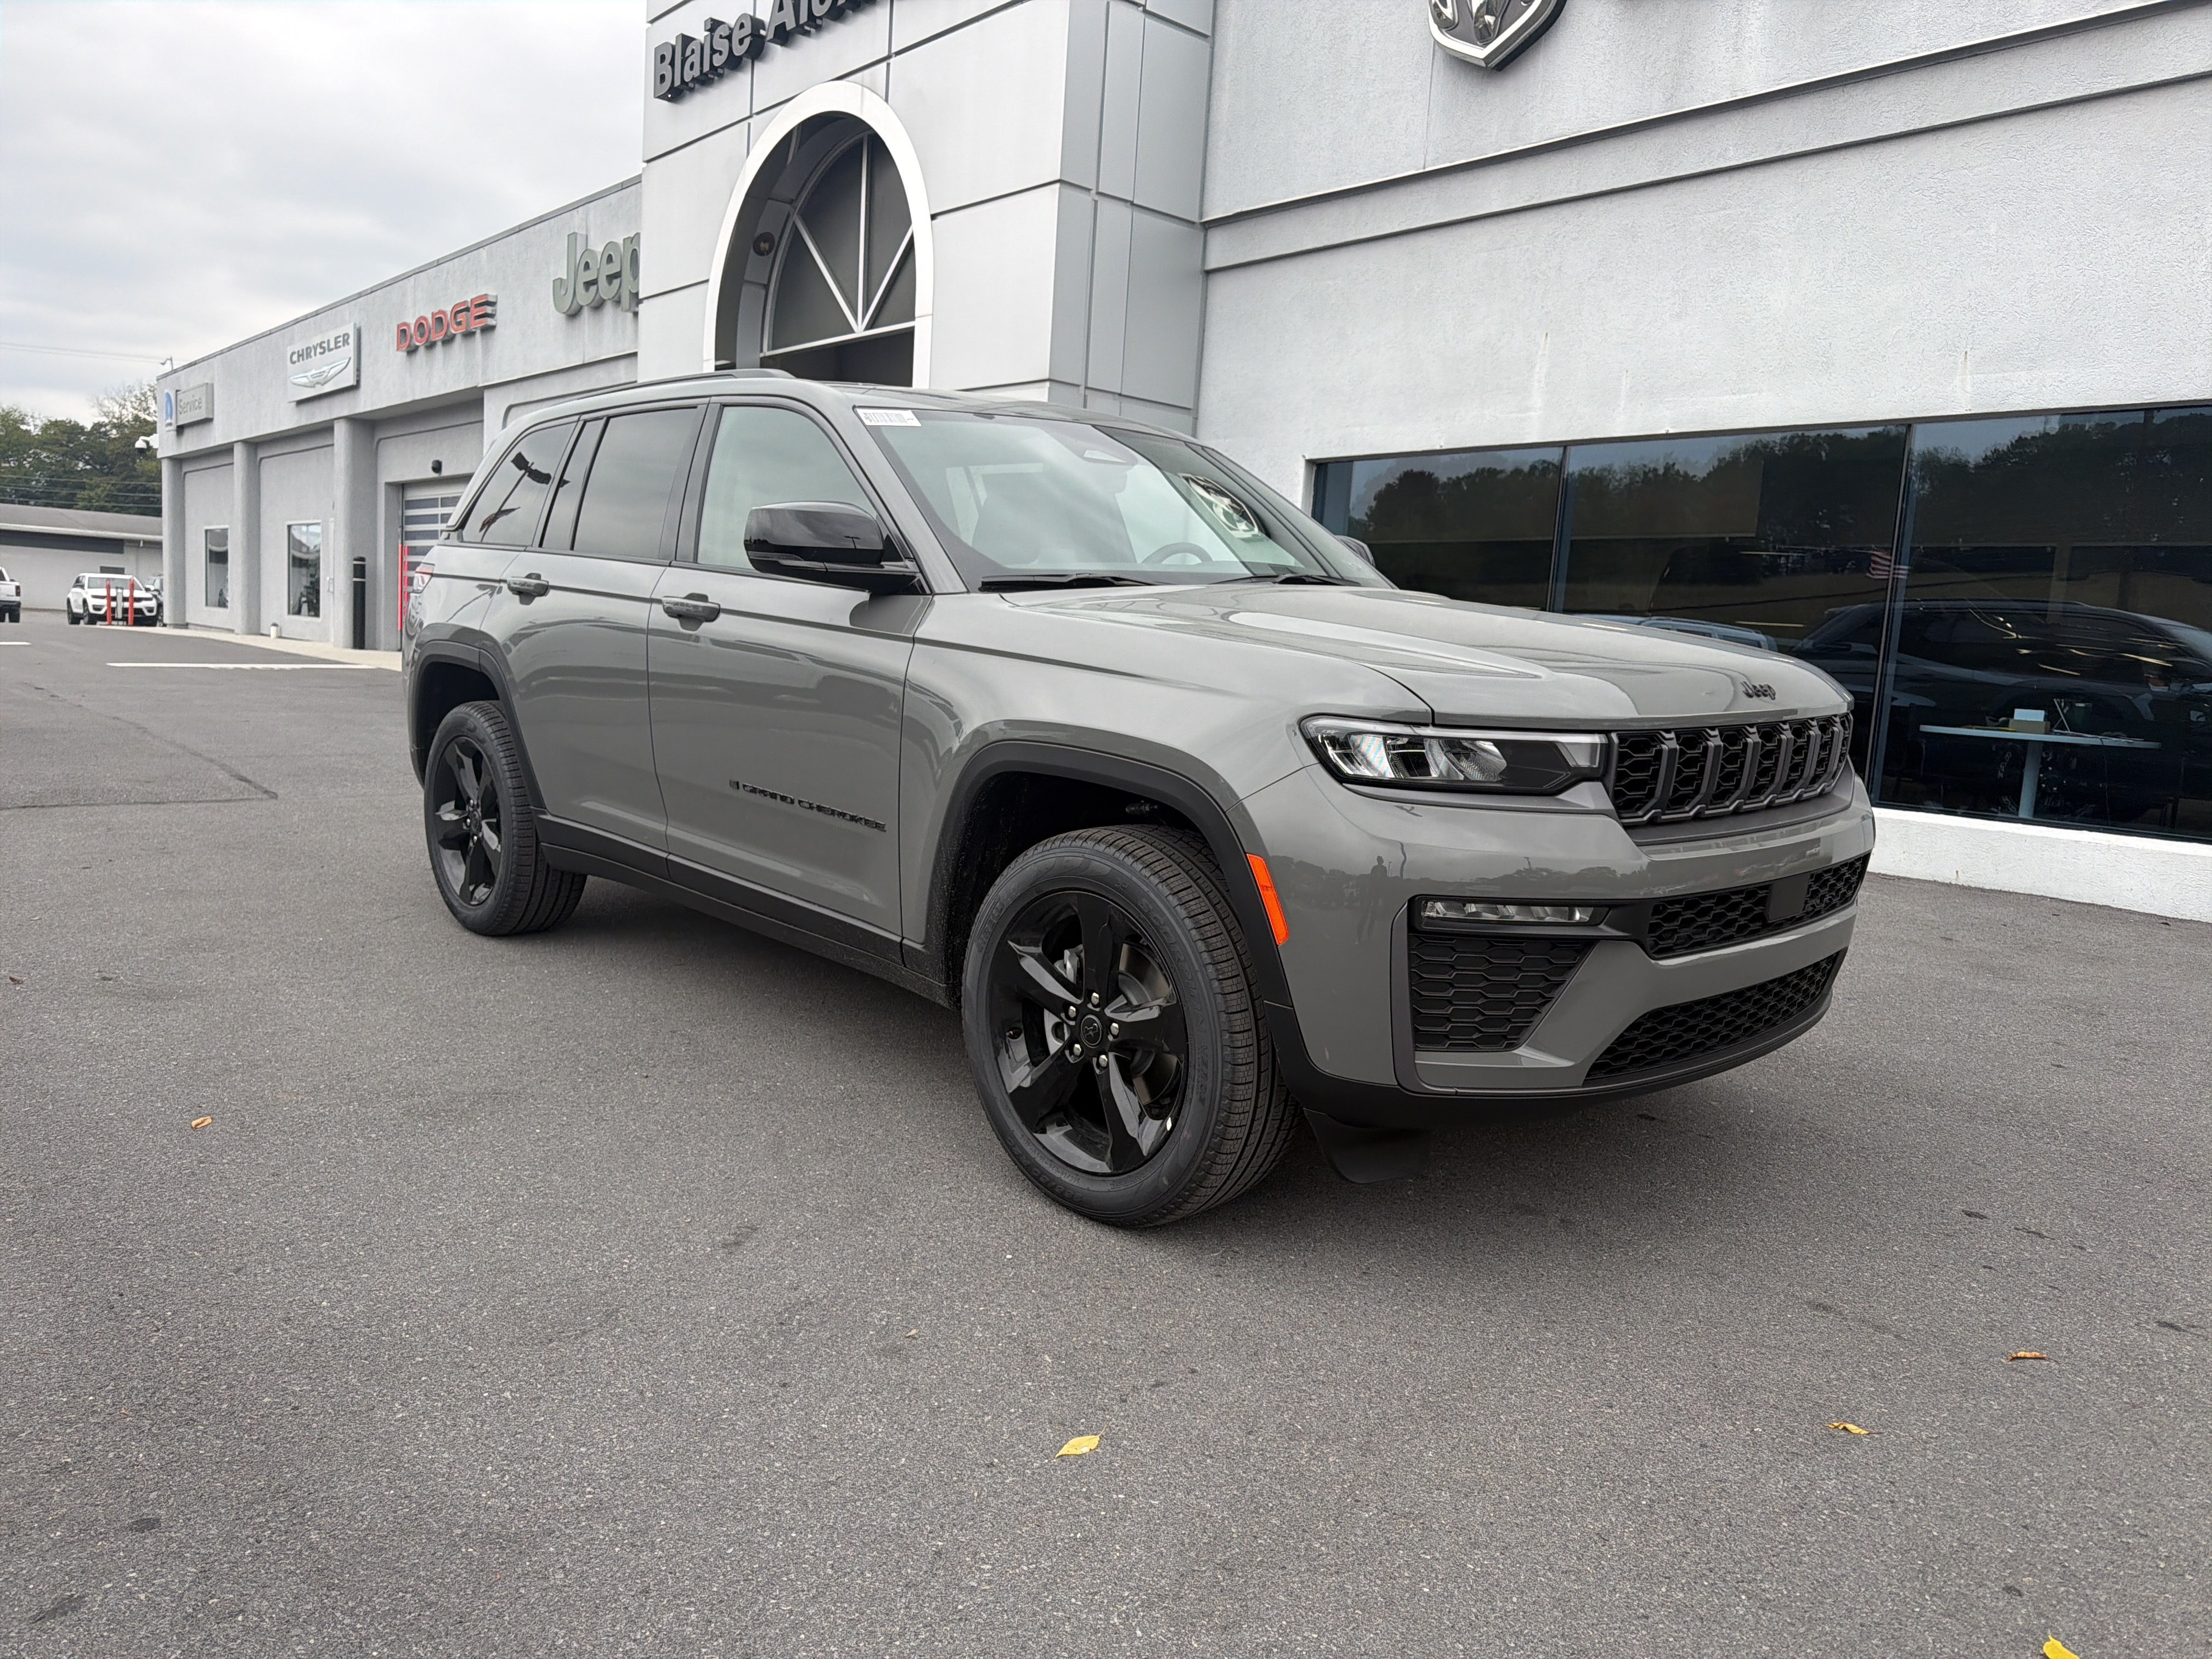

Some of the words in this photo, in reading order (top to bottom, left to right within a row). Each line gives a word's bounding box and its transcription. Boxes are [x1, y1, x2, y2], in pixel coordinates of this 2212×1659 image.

[654, 13, 759, 99] Blaise
[552, 231, 641, 314] Jeep
[397, 294, 491, 352] DODGE
[290, 332, 351, 365] CHRYSLER
[178, 397, 202, 415] Service
[1740, 681, 1776, 701] Jeep
